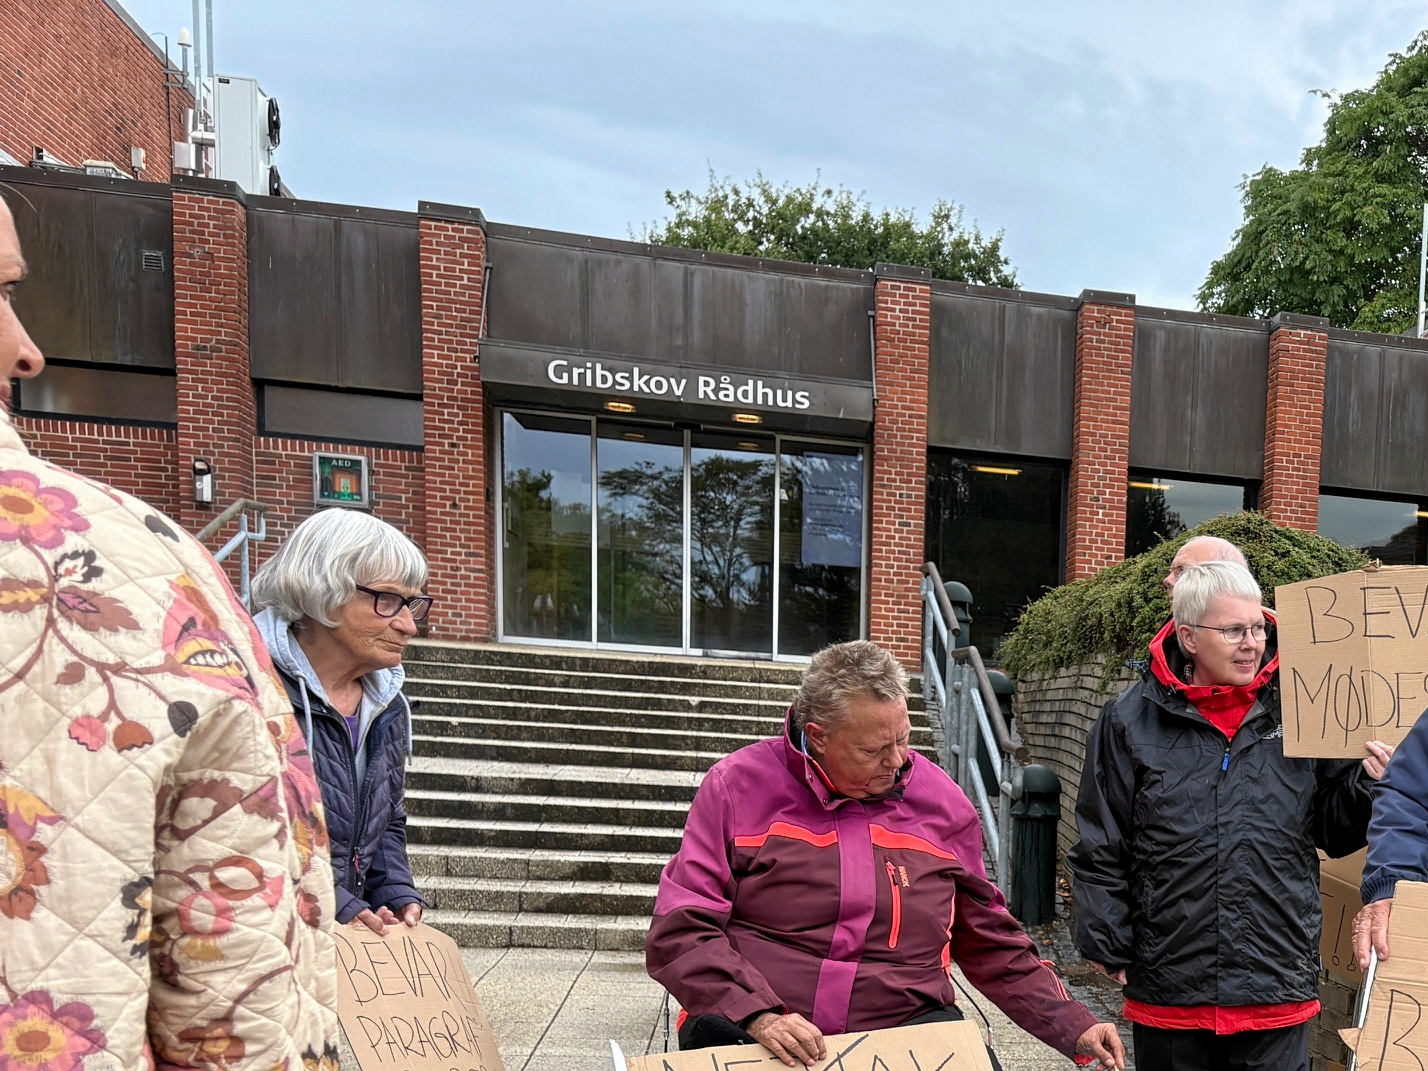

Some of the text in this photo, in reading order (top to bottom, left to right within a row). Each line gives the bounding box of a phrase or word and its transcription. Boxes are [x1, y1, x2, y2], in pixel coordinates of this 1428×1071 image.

[547, 360, 811, 410] Gribskov Rådhus
[331, 458, 352, 468] AED
[334, 932, 468, 1012] BEVAR
[356, 1010, 483, 1063] PARAGRAF
